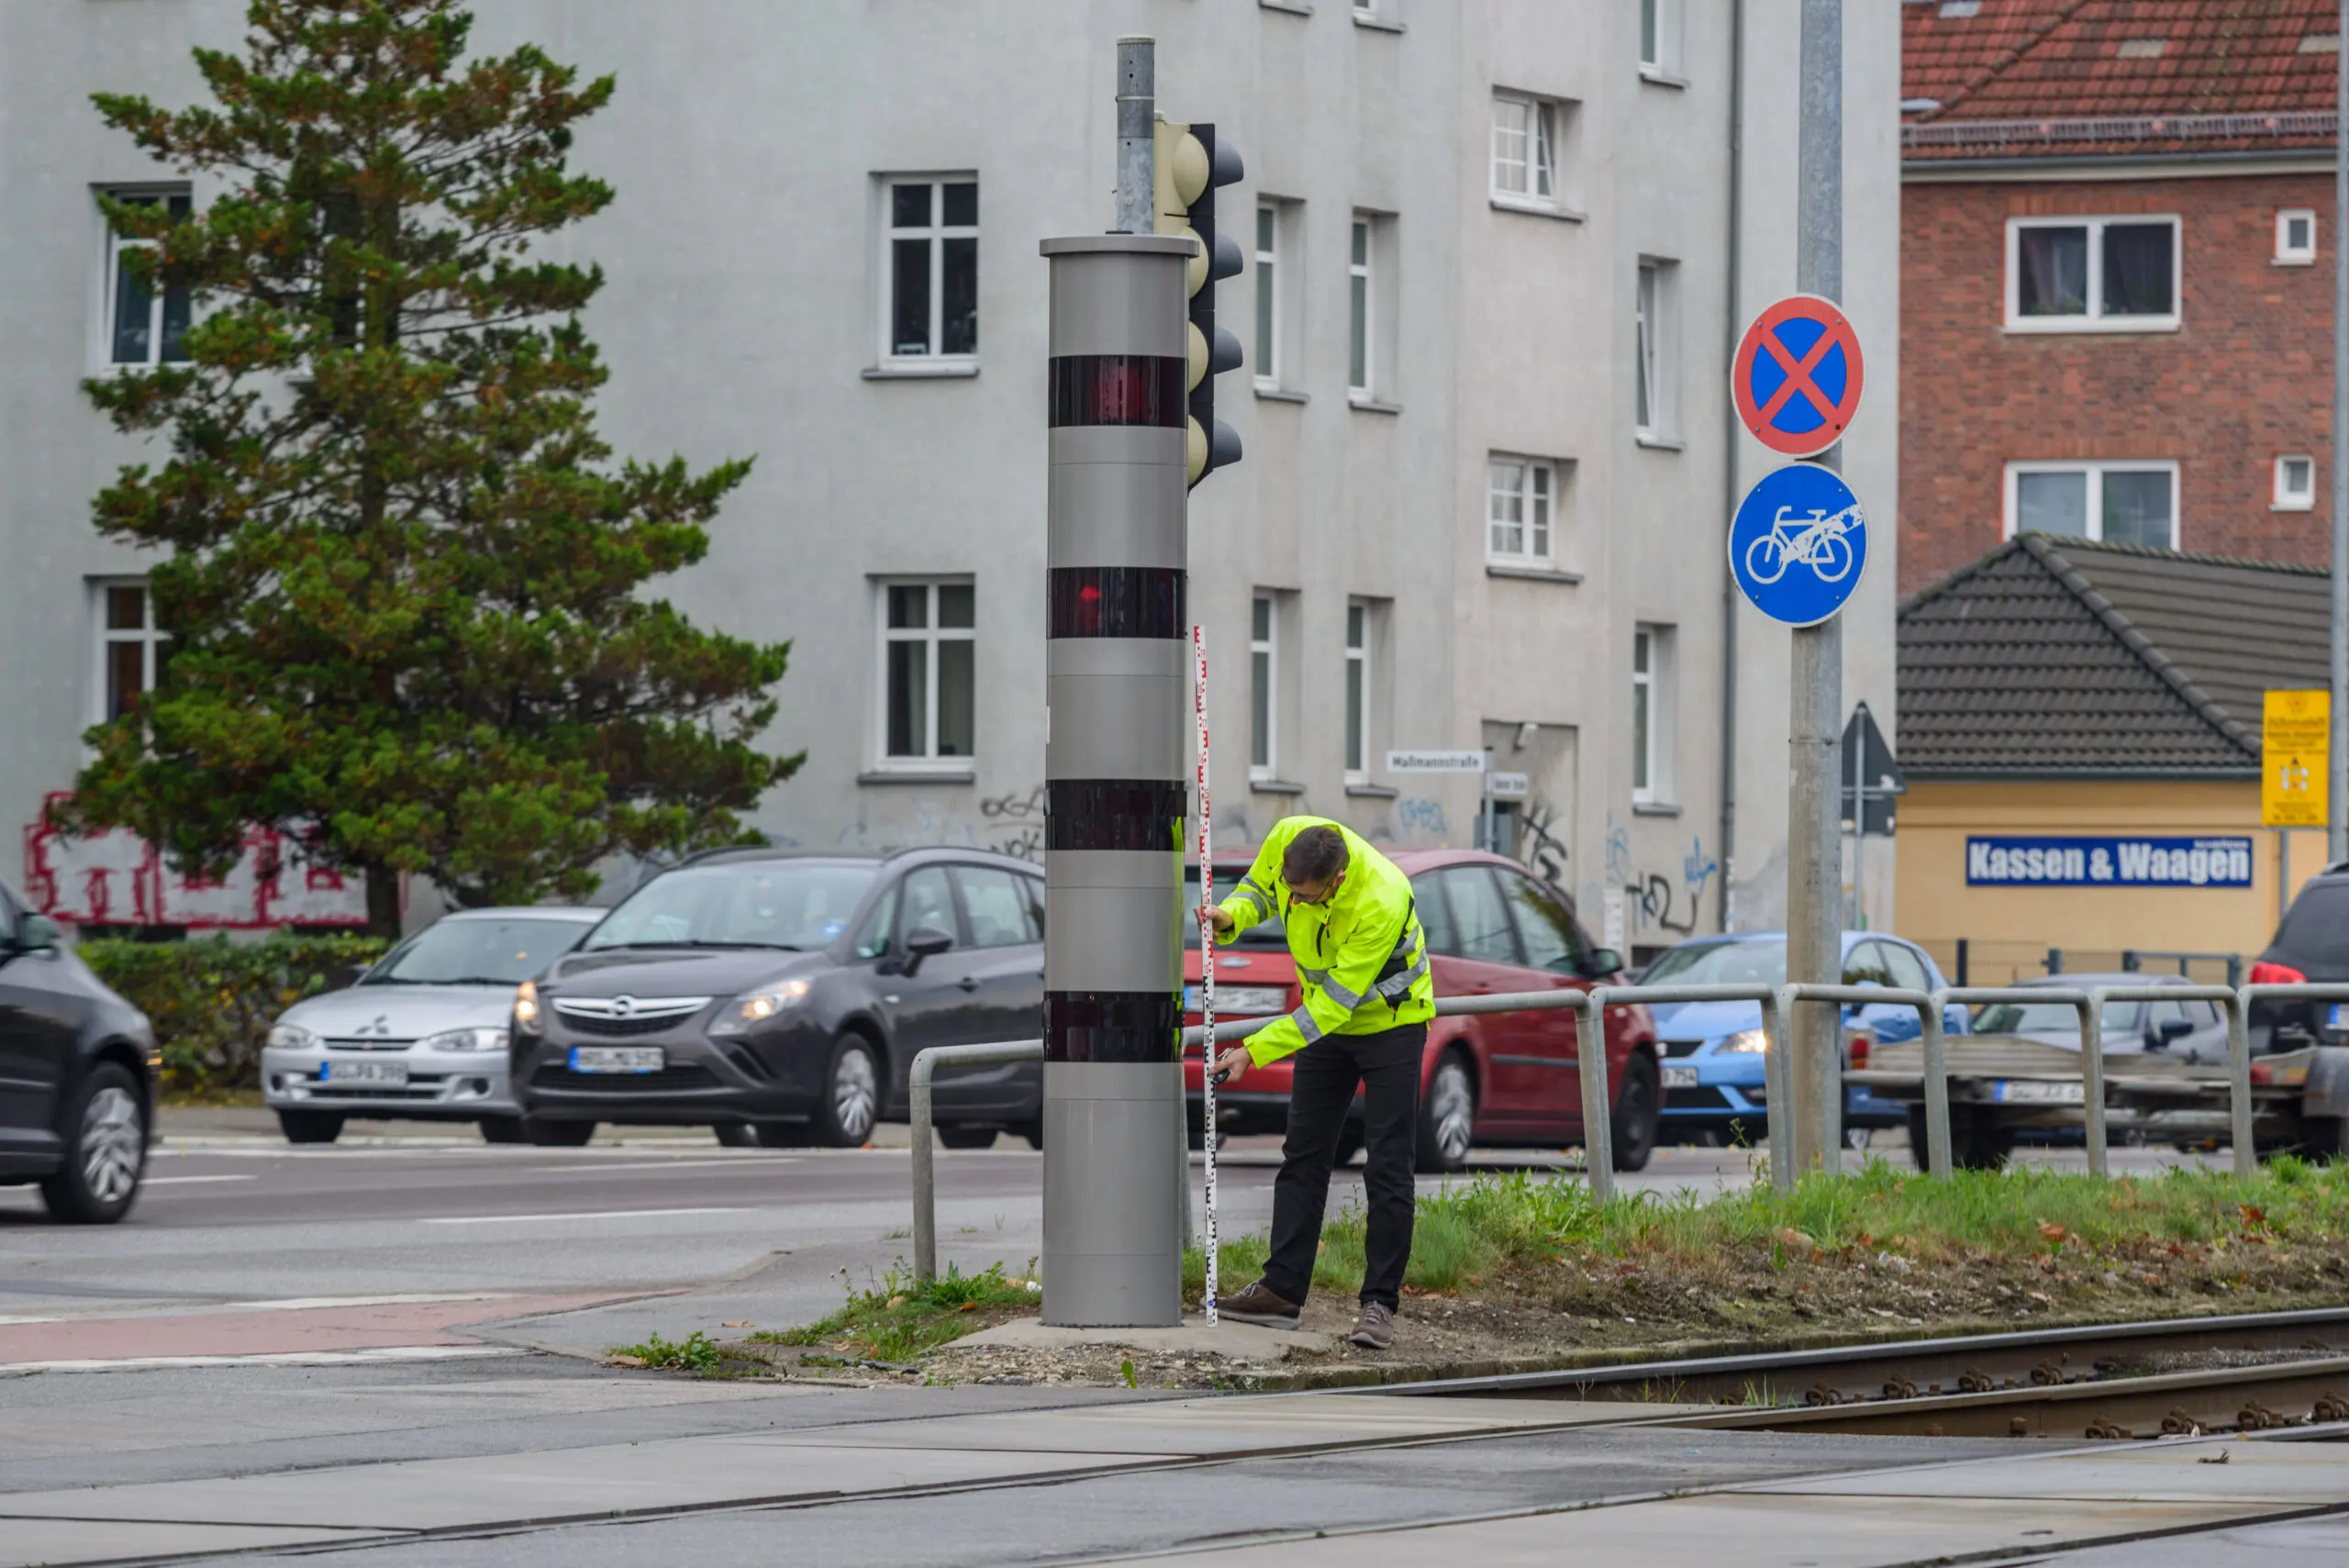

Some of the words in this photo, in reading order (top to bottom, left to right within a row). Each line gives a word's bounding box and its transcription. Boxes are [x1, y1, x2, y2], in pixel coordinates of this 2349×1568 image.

[1969, 841, 2085, 880] Kassen
[2088, 847, 2114, 880] &
[2117, 842, 2249, 884] Waagen
